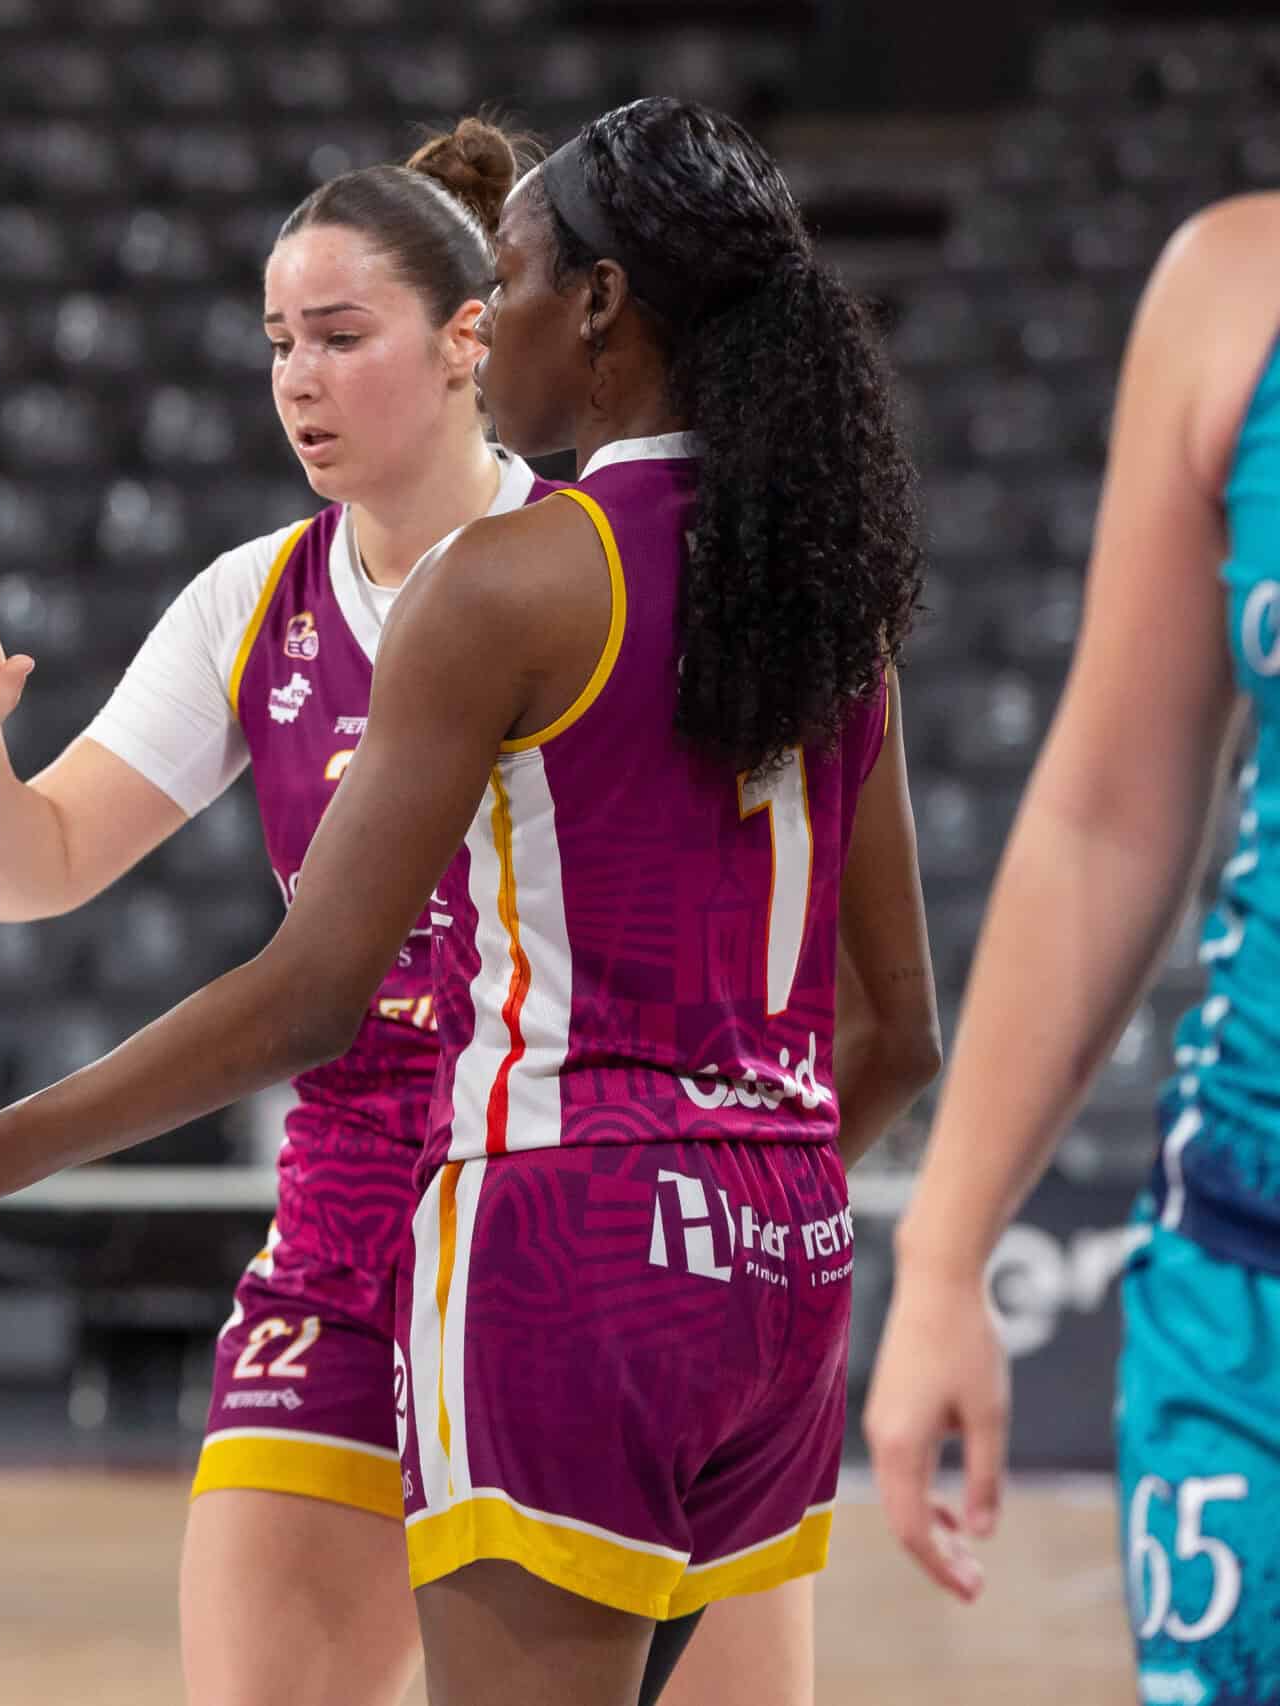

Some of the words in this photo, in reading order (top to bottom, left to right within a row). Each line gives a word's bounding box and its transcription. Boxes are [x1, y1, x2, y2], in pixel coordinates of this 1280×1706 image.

[736, 744, 813, 1018] 1
[233, 1314, 321, 1379] 22
[1127, 1474, 1249, 1642] 65
